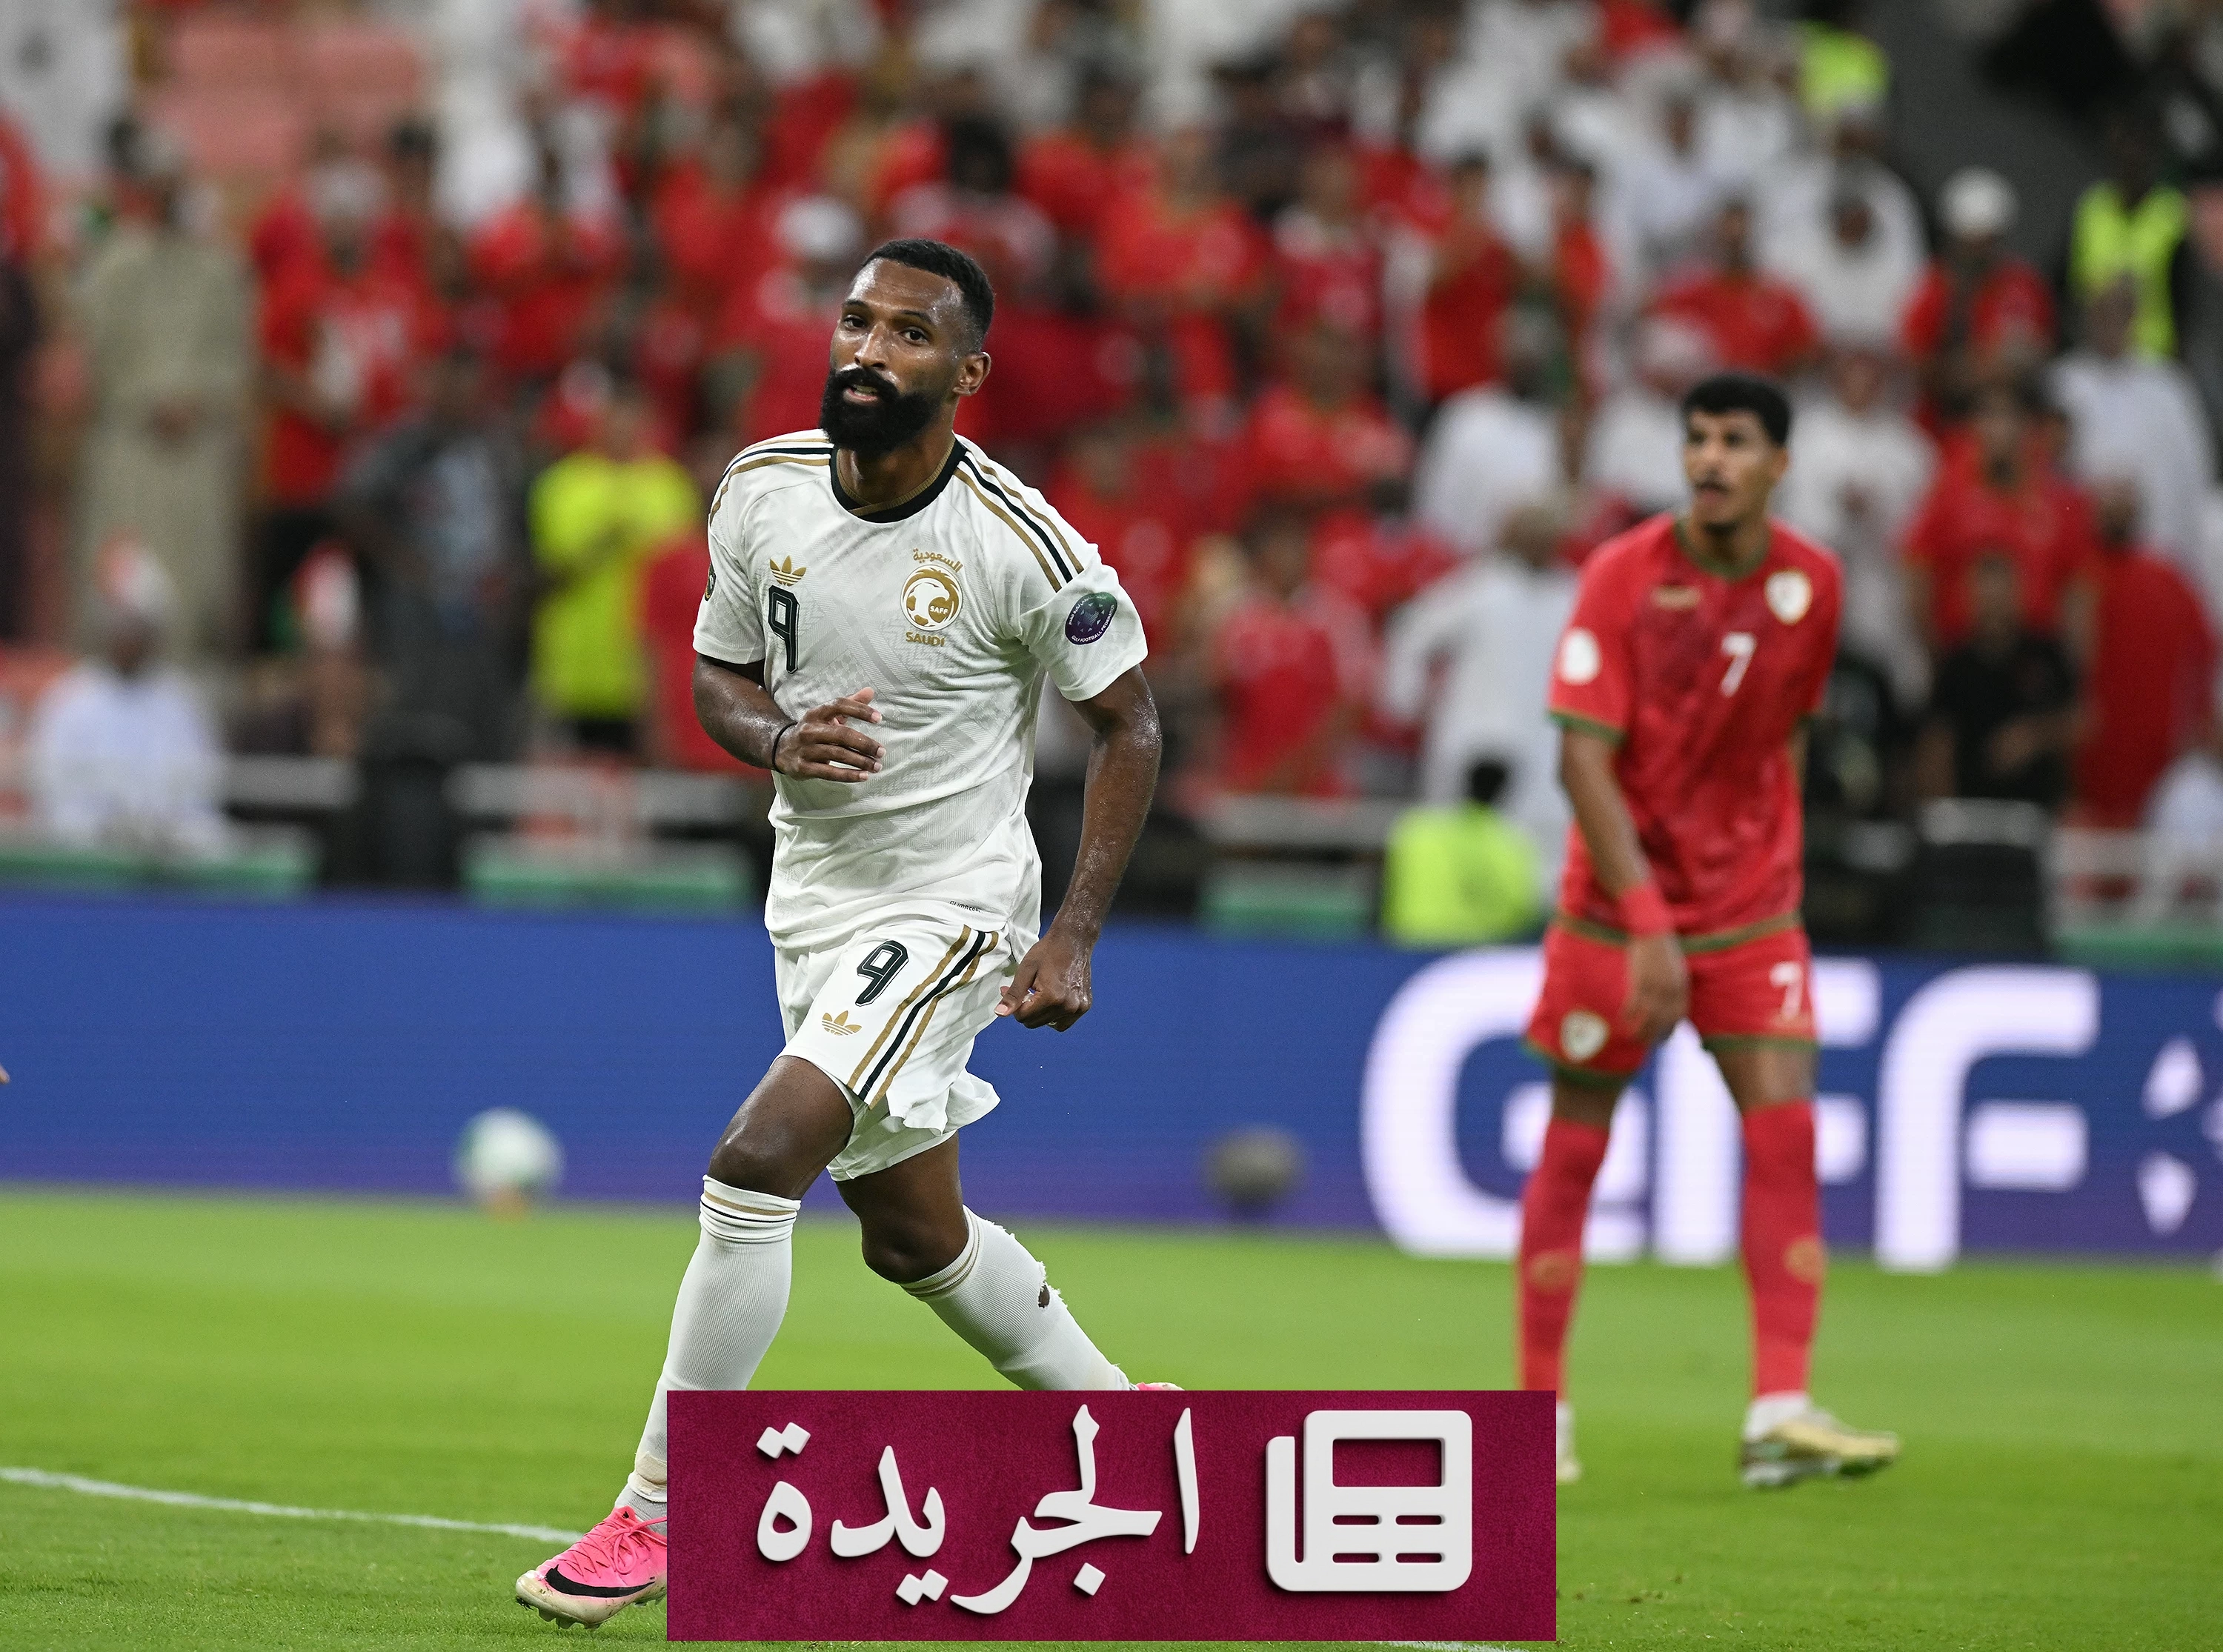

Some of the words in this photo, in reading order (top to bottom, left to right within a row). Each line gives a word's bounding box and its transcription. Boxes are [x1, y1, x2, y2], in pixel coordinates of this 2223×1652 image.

[912, 548, 963, 573] السعودية
[768, 585, 800, 674] 9
[929, 605, 948, 615] SAFF
[906, 632, 946, 647] SAUDI
[1080, 630, 1103, 642] FOOTBALL
[1720, 630, 1757, 698] 7
[855, 939, 909, 1007] 9
[1768, 962, 1804, 1020] 7
